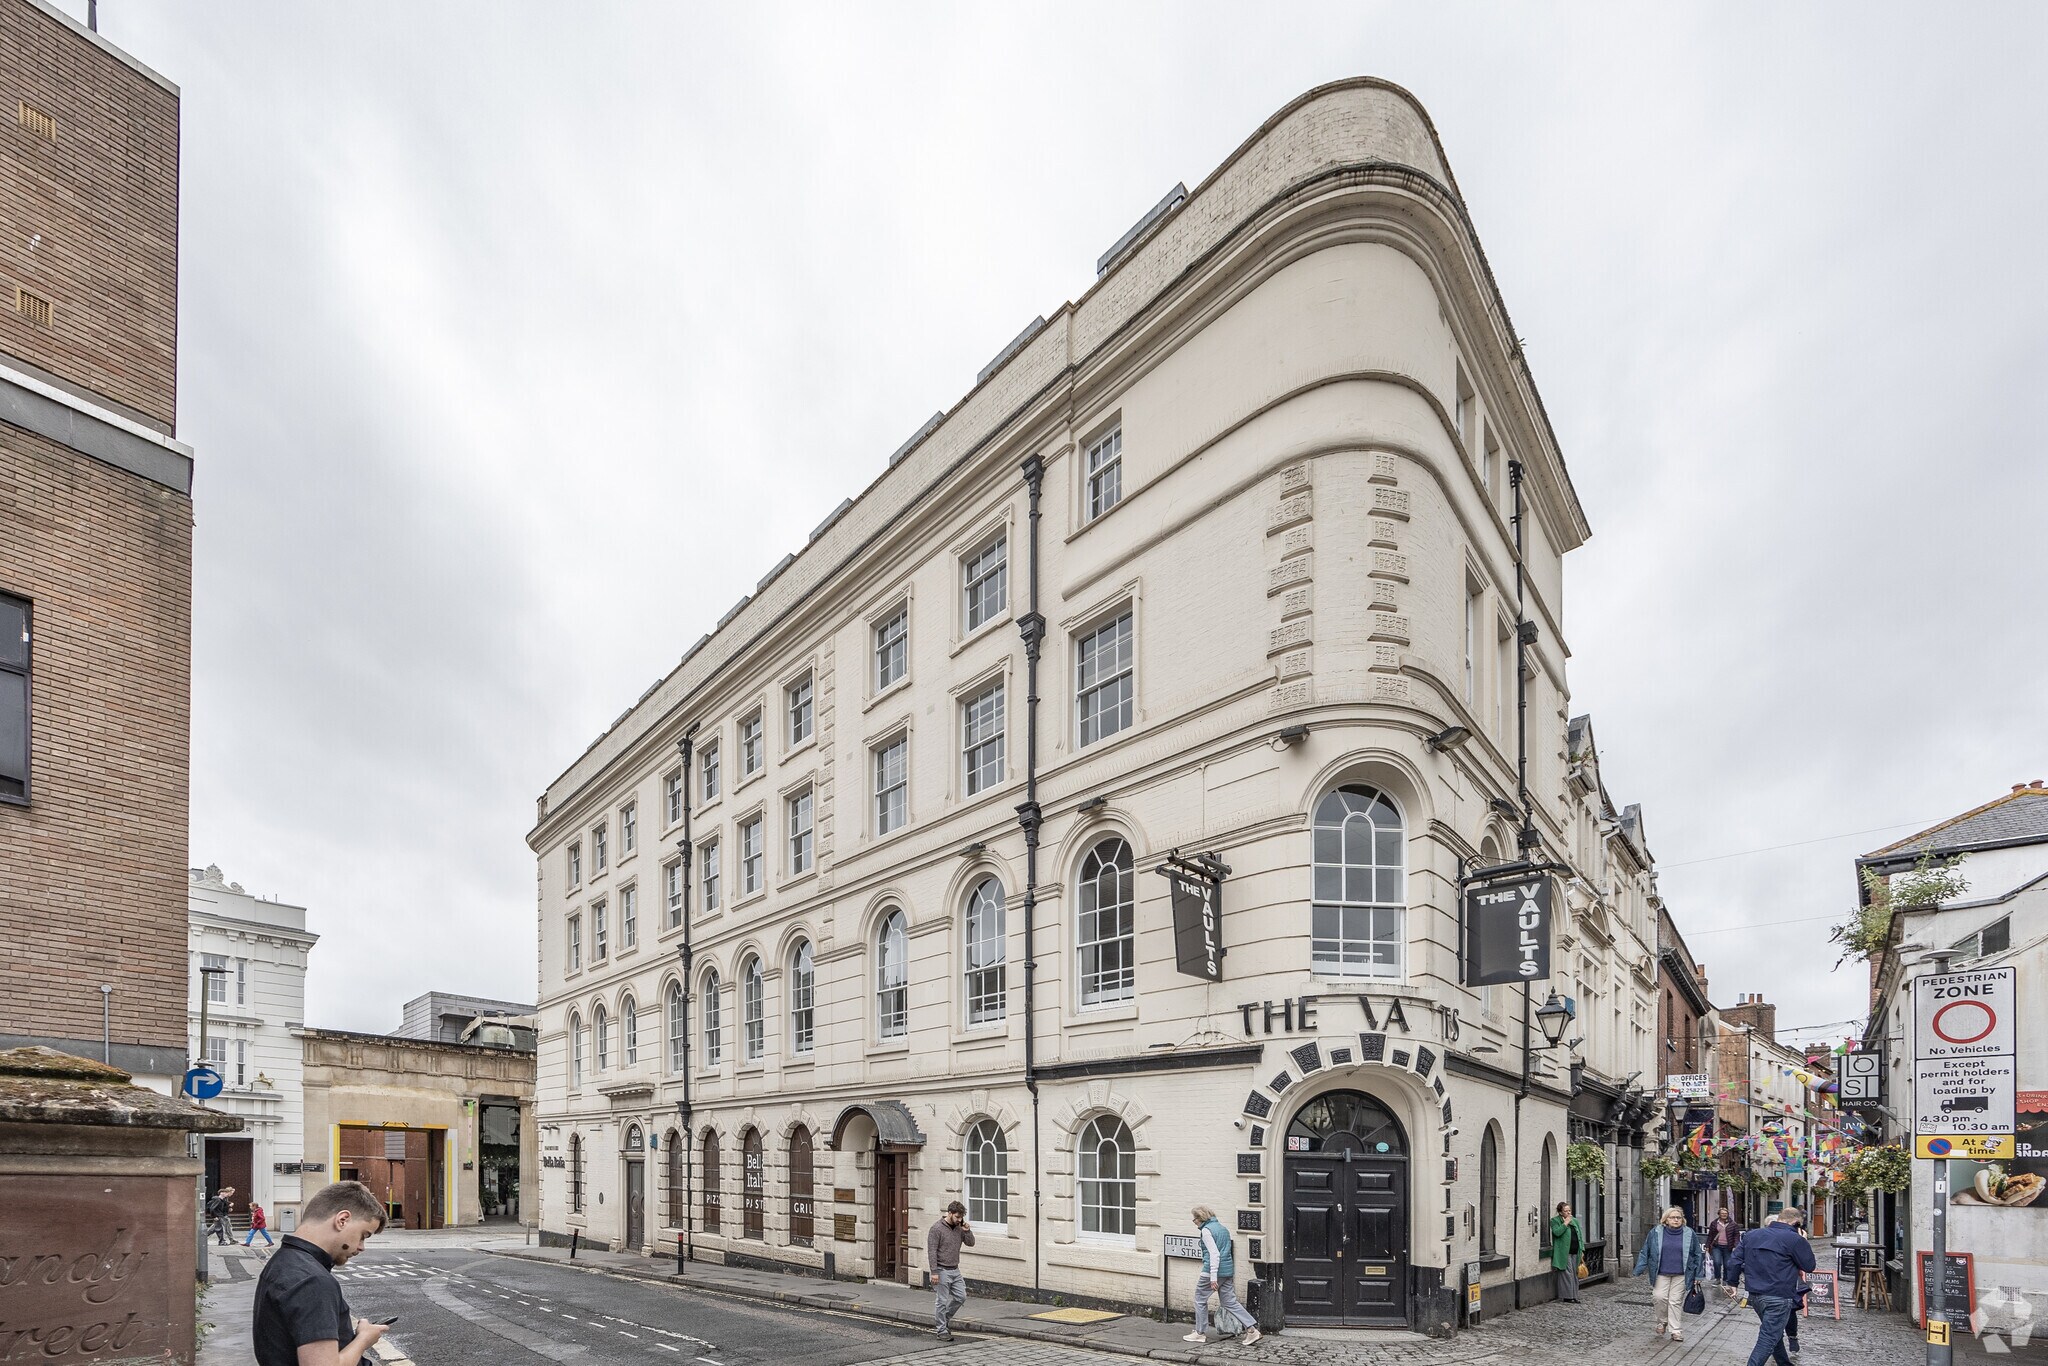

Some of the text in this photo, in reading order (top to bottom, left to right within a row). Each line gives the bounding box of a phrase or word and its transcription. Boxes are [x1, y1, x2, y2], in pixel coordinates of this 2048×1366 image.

[1179, 880, 1217, 976] THE VAULTS
[1477, 883, 1541, 976] THE VAULTS
[1923, 972, 2007, 986] PEDESTRIAN
[1934, 983, 1994, 999] ZONE
[1237, 995, 1317, 1035] THE
[1950, 1045, 2000, 1054] Vehicles
[1944, 1060, 1985, 1069] Except
[1920, 1069, 2010, 1079] permit holders
[1942, 1078, 1964, 1086] and
[1933, 1086, 1996, 1095] loading by
[1920, 1115, 1950, 1123] 4.30
[1952, 1115, 1970, 1123] pm
[1953, 1123, 1988, 1131] 10.30
[1962, 1138, 2002, 1148] At ay
[747, 1173, 763, 1188] Itali
[746, 1199, 763, 1209] PAST
[794, 1202, 813, 1214] GRIL
[1166, 1236, 1193, 1247] LITTLE
[1181, 1248, 1202, 1257] STRE
[0, 1228, 149, 1305] andy
[0, 1312, 142, 1358] reet
